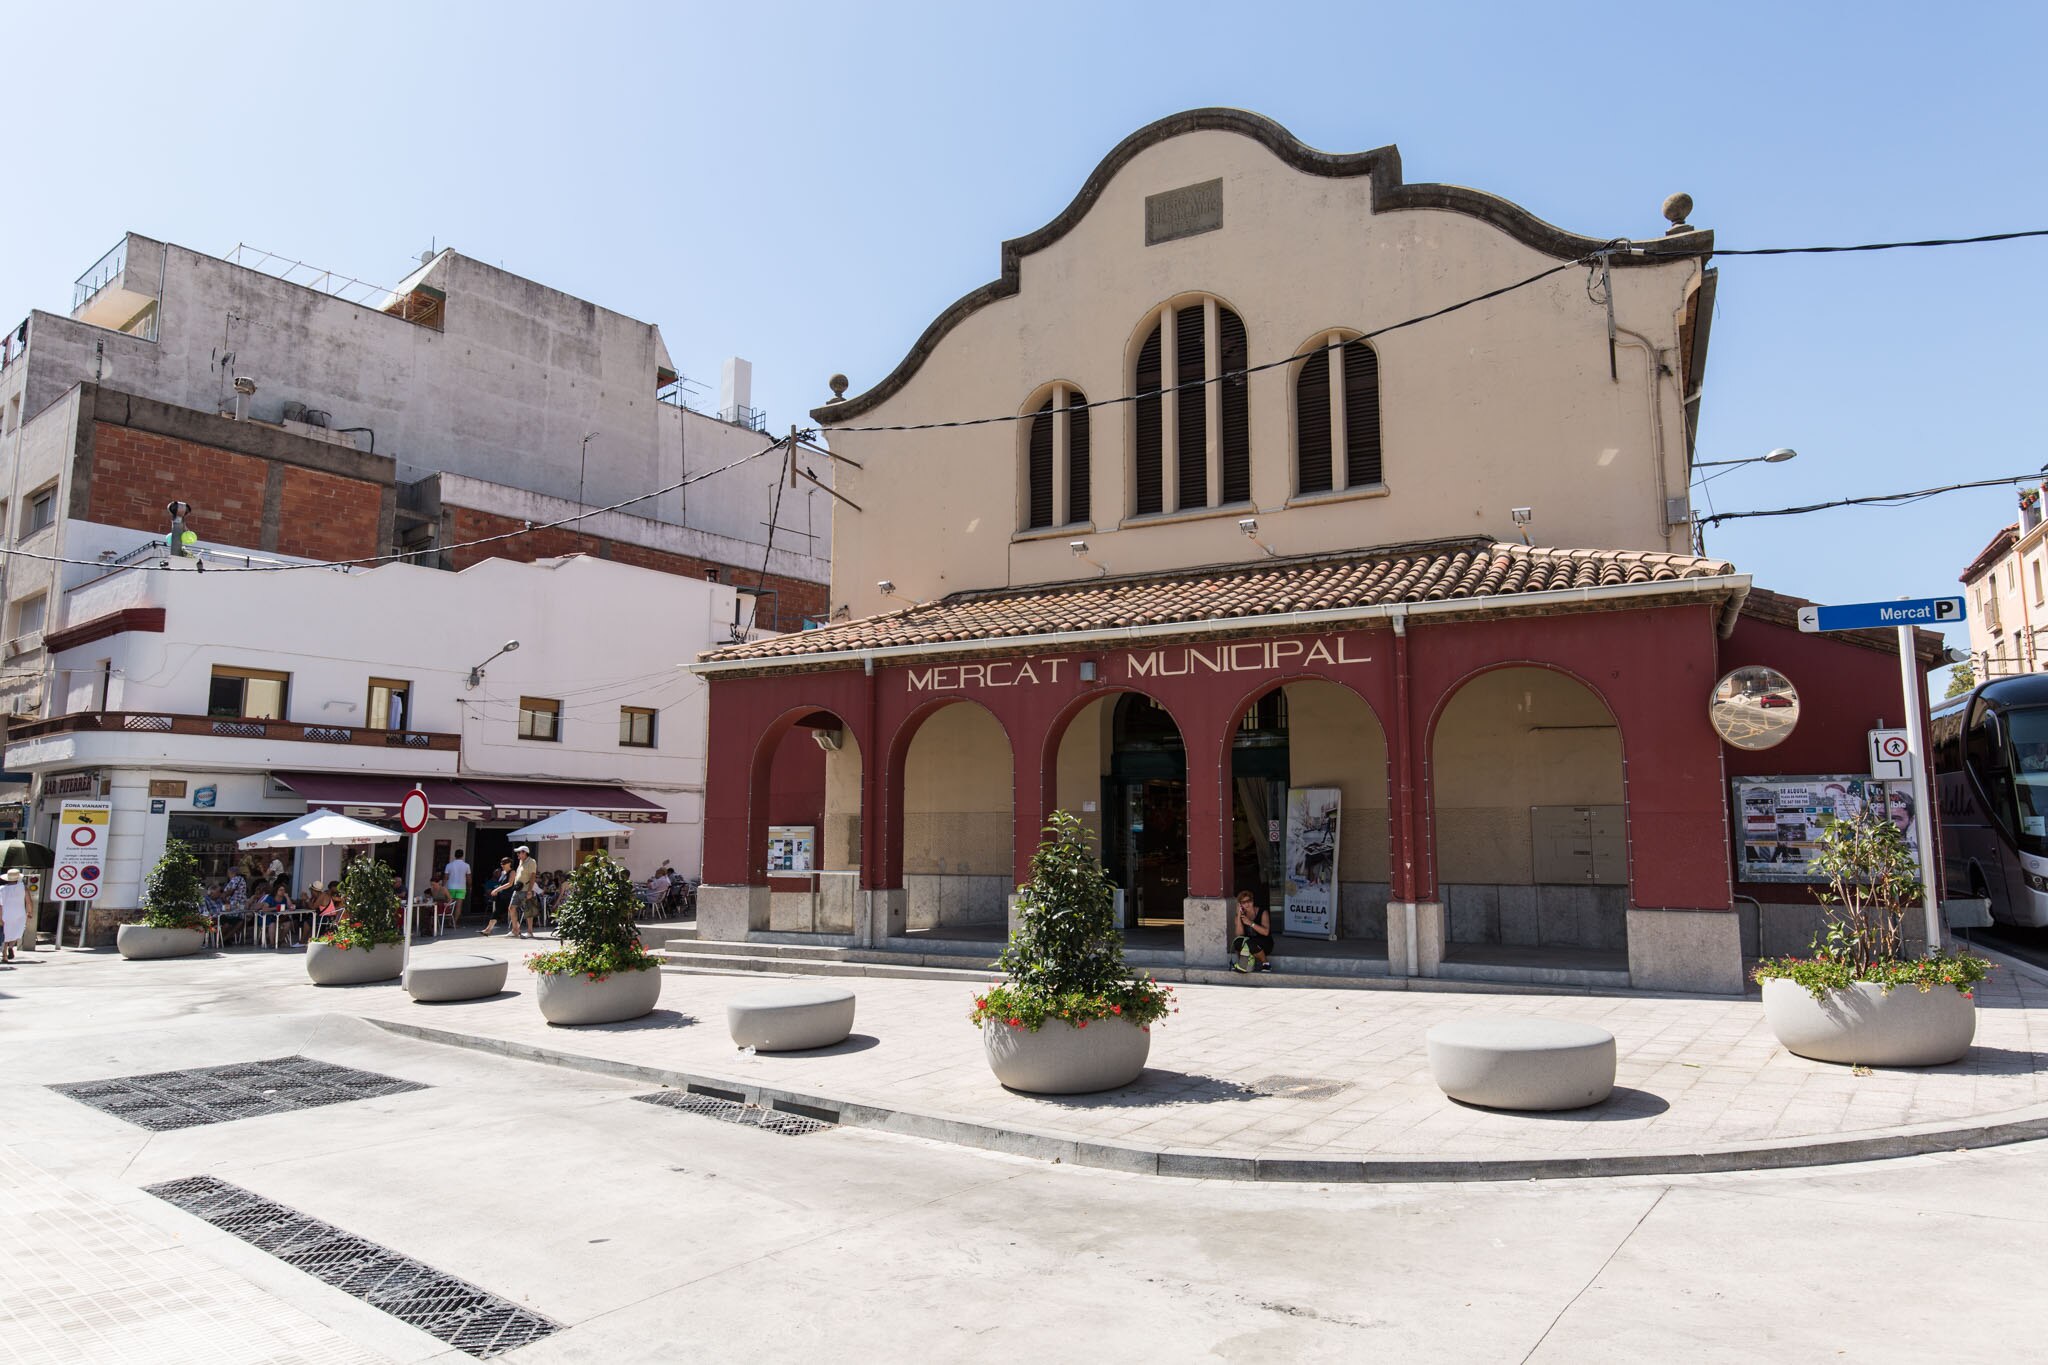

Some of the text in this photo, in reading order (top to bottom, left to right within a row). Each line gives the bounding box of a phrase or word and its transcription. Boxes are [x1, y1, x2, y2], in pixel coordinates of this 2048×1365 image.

[1880, 601, 1954, 620] Mercat P
[907, 637, 1371, 691] MERCAT MUNICIPAL
[44, 780, 57, 795] BAR
[1870, 801, 1906, 811] poible
[497, 808, 651, 821] PIFRER
[1290, 905, 1327, 914] CALELLA
